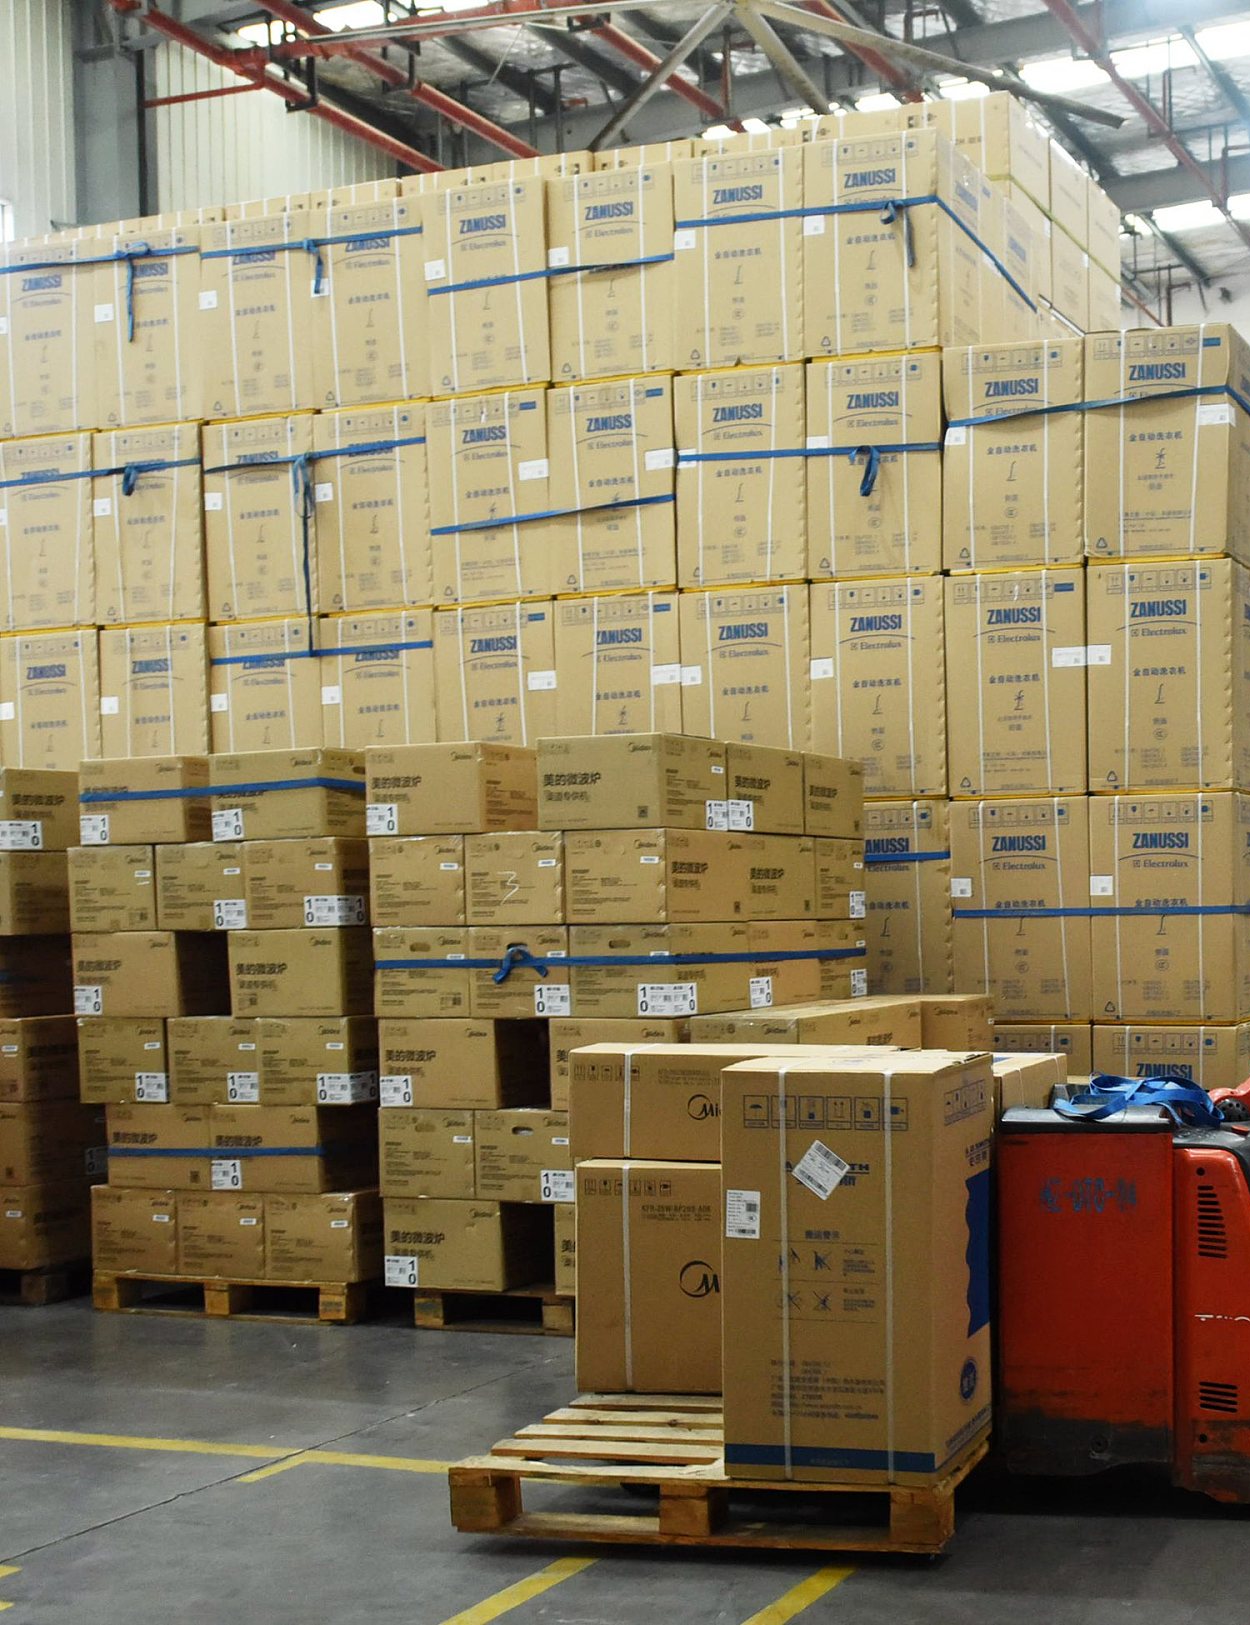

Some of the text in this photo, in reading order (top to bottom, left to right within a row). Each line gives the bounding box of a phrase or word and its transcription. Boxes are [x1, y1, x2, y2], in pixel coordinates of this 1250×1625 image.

[844, 168, 896, 188] ZANUSSI
[713, 185, 763, 205] ZANUSSI
[585, 201, 634, 221] ZANUSSI
[460, 214, 506, 234] ZANUSSI
[1129, 362, 1186, 381] ZANUSSI
[985, 378, 1039, 397] ZANUSSI
[847, 391, 899, 409] ZANUSSI
[713, 403, 763, 423] ZANUSSI
[586, 414, 632, 433] ZANUSS
[856, 419, 899, 429] Electrolux
[462, 425, 506, 444] ZANUSS
[1129, 431, 1183, 442] 全自动洗衣机
[987, 444, 1037, 456] 全自动洗衣机
[987, 606, 1041, 625] ZANUSSI
[1130, 599, 1187, 618] ZANUSSI
[718, 622, 768, 640] ZANUSSI
[849, 614, 902, 632] ZANUSSI
[997, 634, 1041, 644] Electrolux
[1141, 628, 1187, 637] Electrolux
[470, 635, 517, 653] ZANUSSI
[860, 640, 902, 650] Electrolux
[729, 649, 768, 658] Electrolux
[989, 673, 1041, 684] 全自动洗衣机
[1133, 667, 1186, 677] 全自动洗衣机
[722, 685, 769, 696] 全自动洗衣机
[852, 678, 901, 689] 全自动洗衣机
[543, 772, 601, 788] 美的微波炉
[865, 837, 909, 853] ANUSSI
[992, 834, 1046, 852] ZANUSSI
[1133, 832, 1189, 849] ZANUSSI
[1002, 861, 1046, 871] Electrolux
[1143, 859, 1189, 868] Electrolux
[995, 898, 1046, 908] 全自动洗衣机
[1135, 897, 1189, 908] 全自动洗衣机
[1137, 1063, 1192, 1078] ZANUSSI
